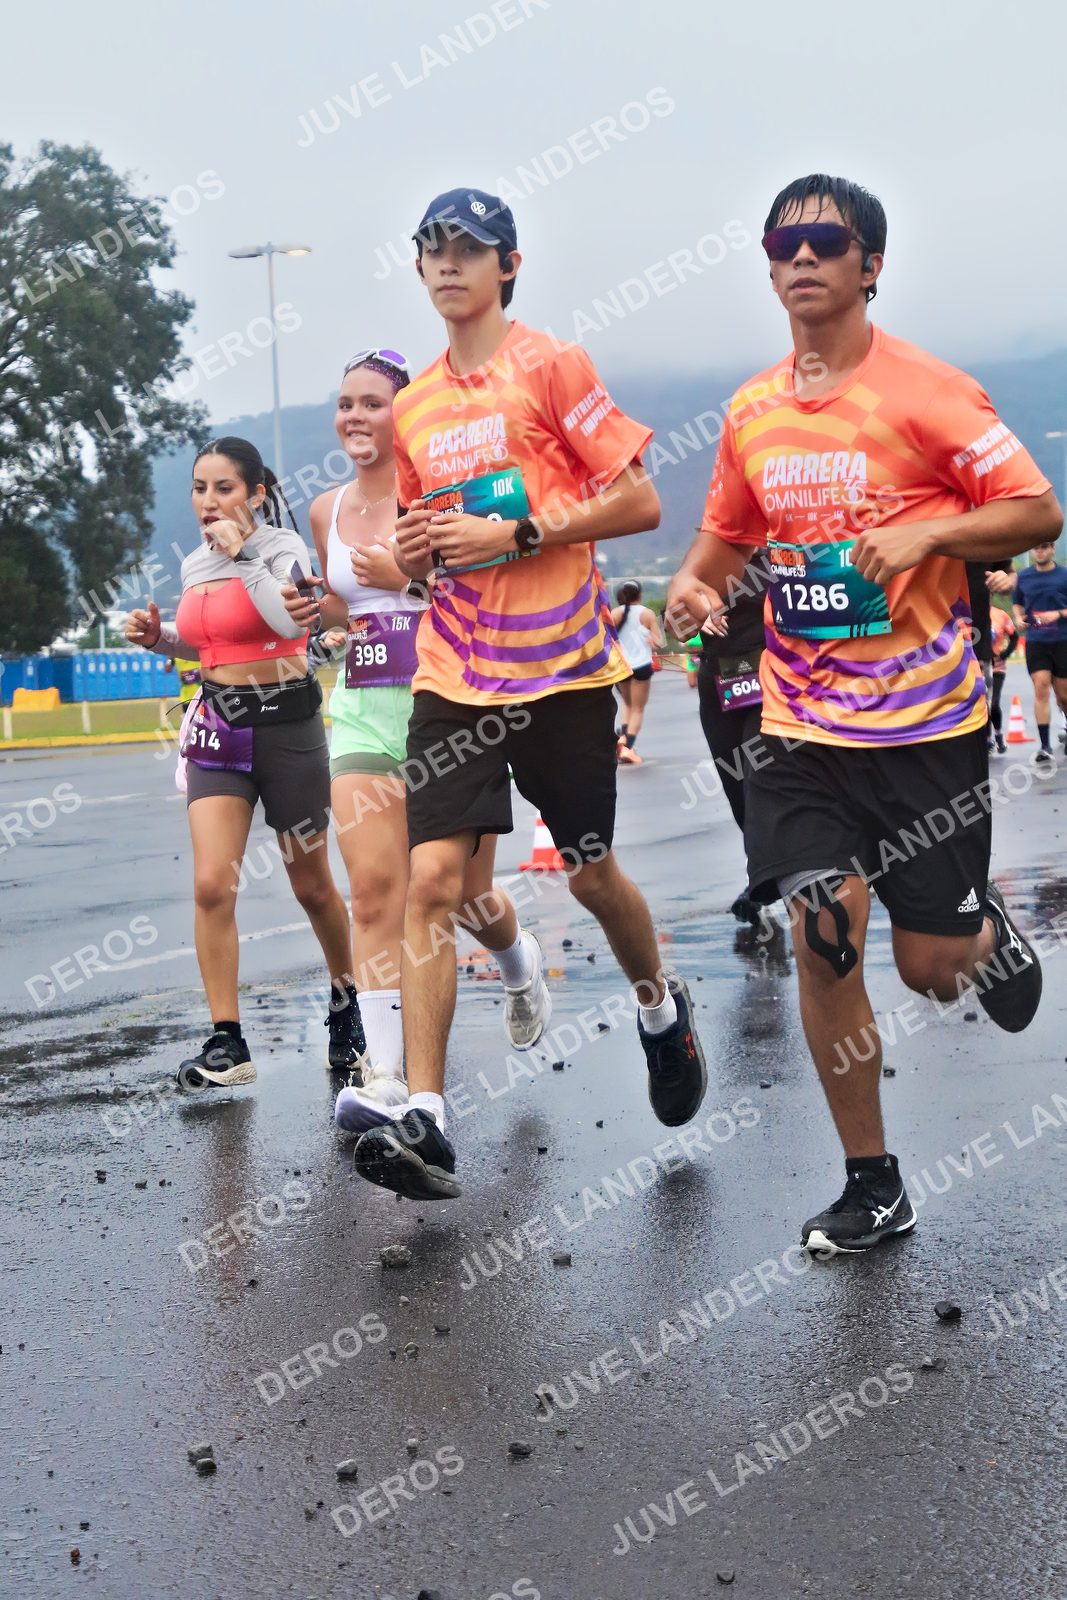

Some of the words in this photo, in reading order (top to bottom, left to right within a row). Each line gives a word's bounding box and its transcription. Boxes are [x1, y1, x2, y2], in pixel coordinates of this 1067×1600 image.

[428, 413, 506, 459] CARRERA
[762, 451, 867, 489] CARRERA
[491, 476, 515, 498] 10K
[764, 486, 840, 512] OMNILIFE
[781, 583, 849, 611] 1286
[391, 616, 411, 631] 15K
[355, 643, 388, 666] 398
[190, 726, 220, 750] 514
[957, 902, 980, 913] adidas
